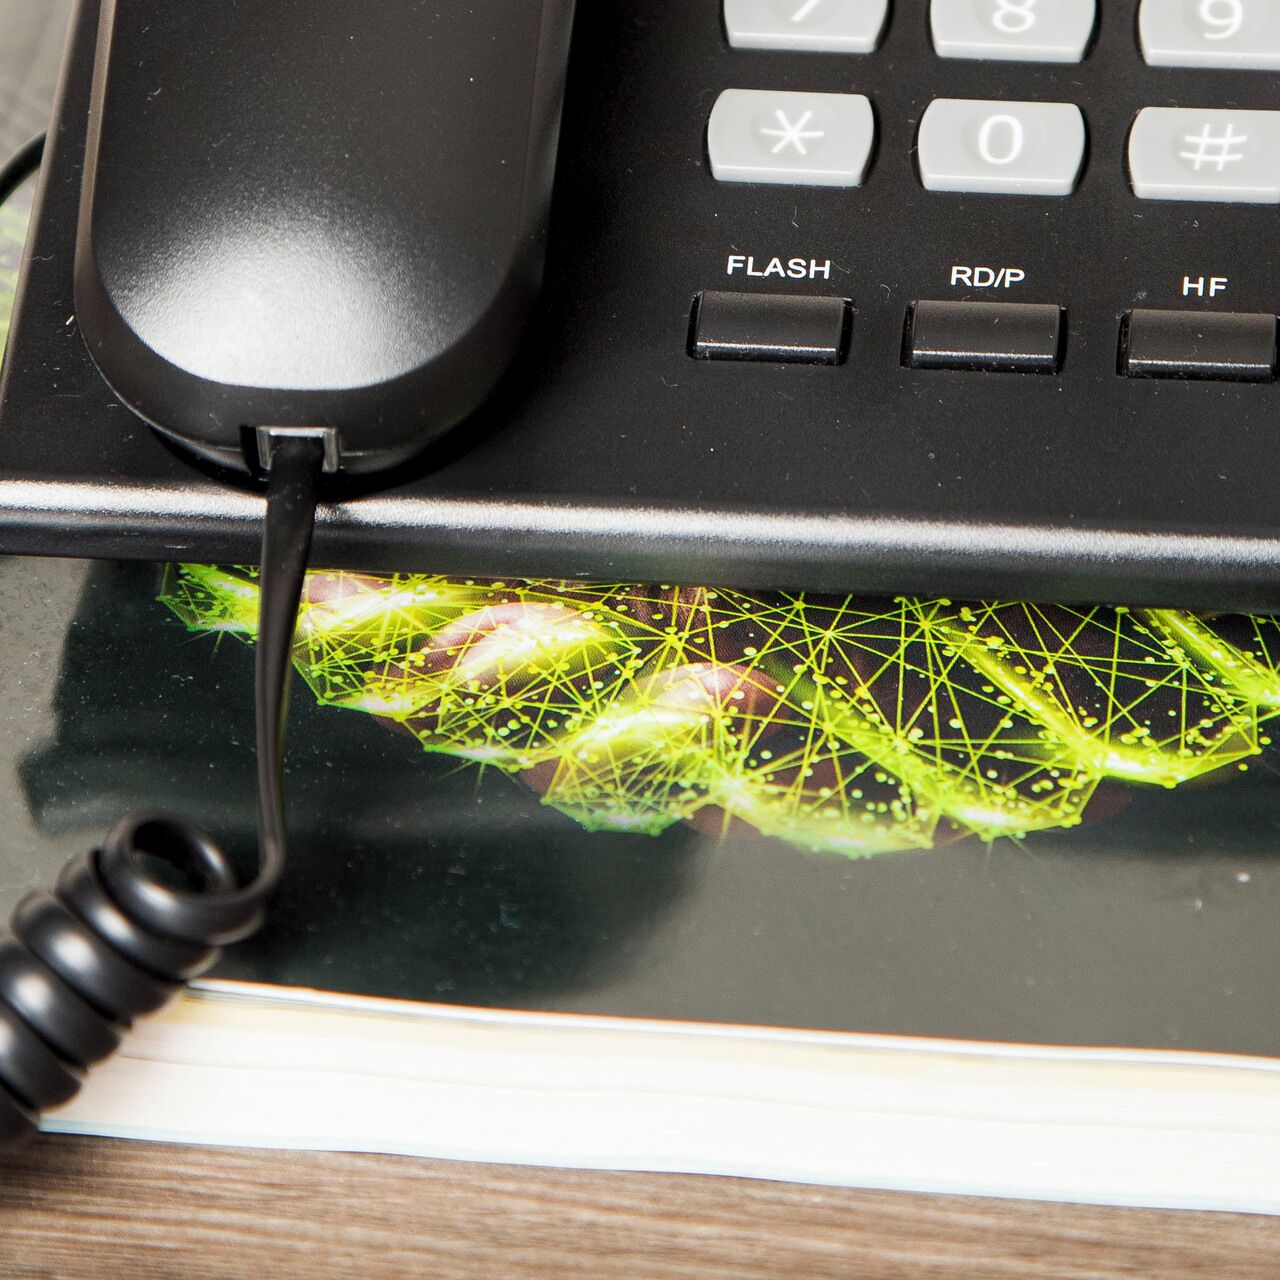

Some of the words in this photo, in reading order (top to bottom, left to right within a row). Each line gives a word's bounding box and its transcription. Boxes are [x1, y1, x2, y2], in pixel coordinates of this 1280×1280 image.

[978, 114, 1023, 164] 0
[726, 255, 831, 280] FLASH
[950, 265, 1025, 288] RD/P
[1182, 276, 1228, 297] HF
